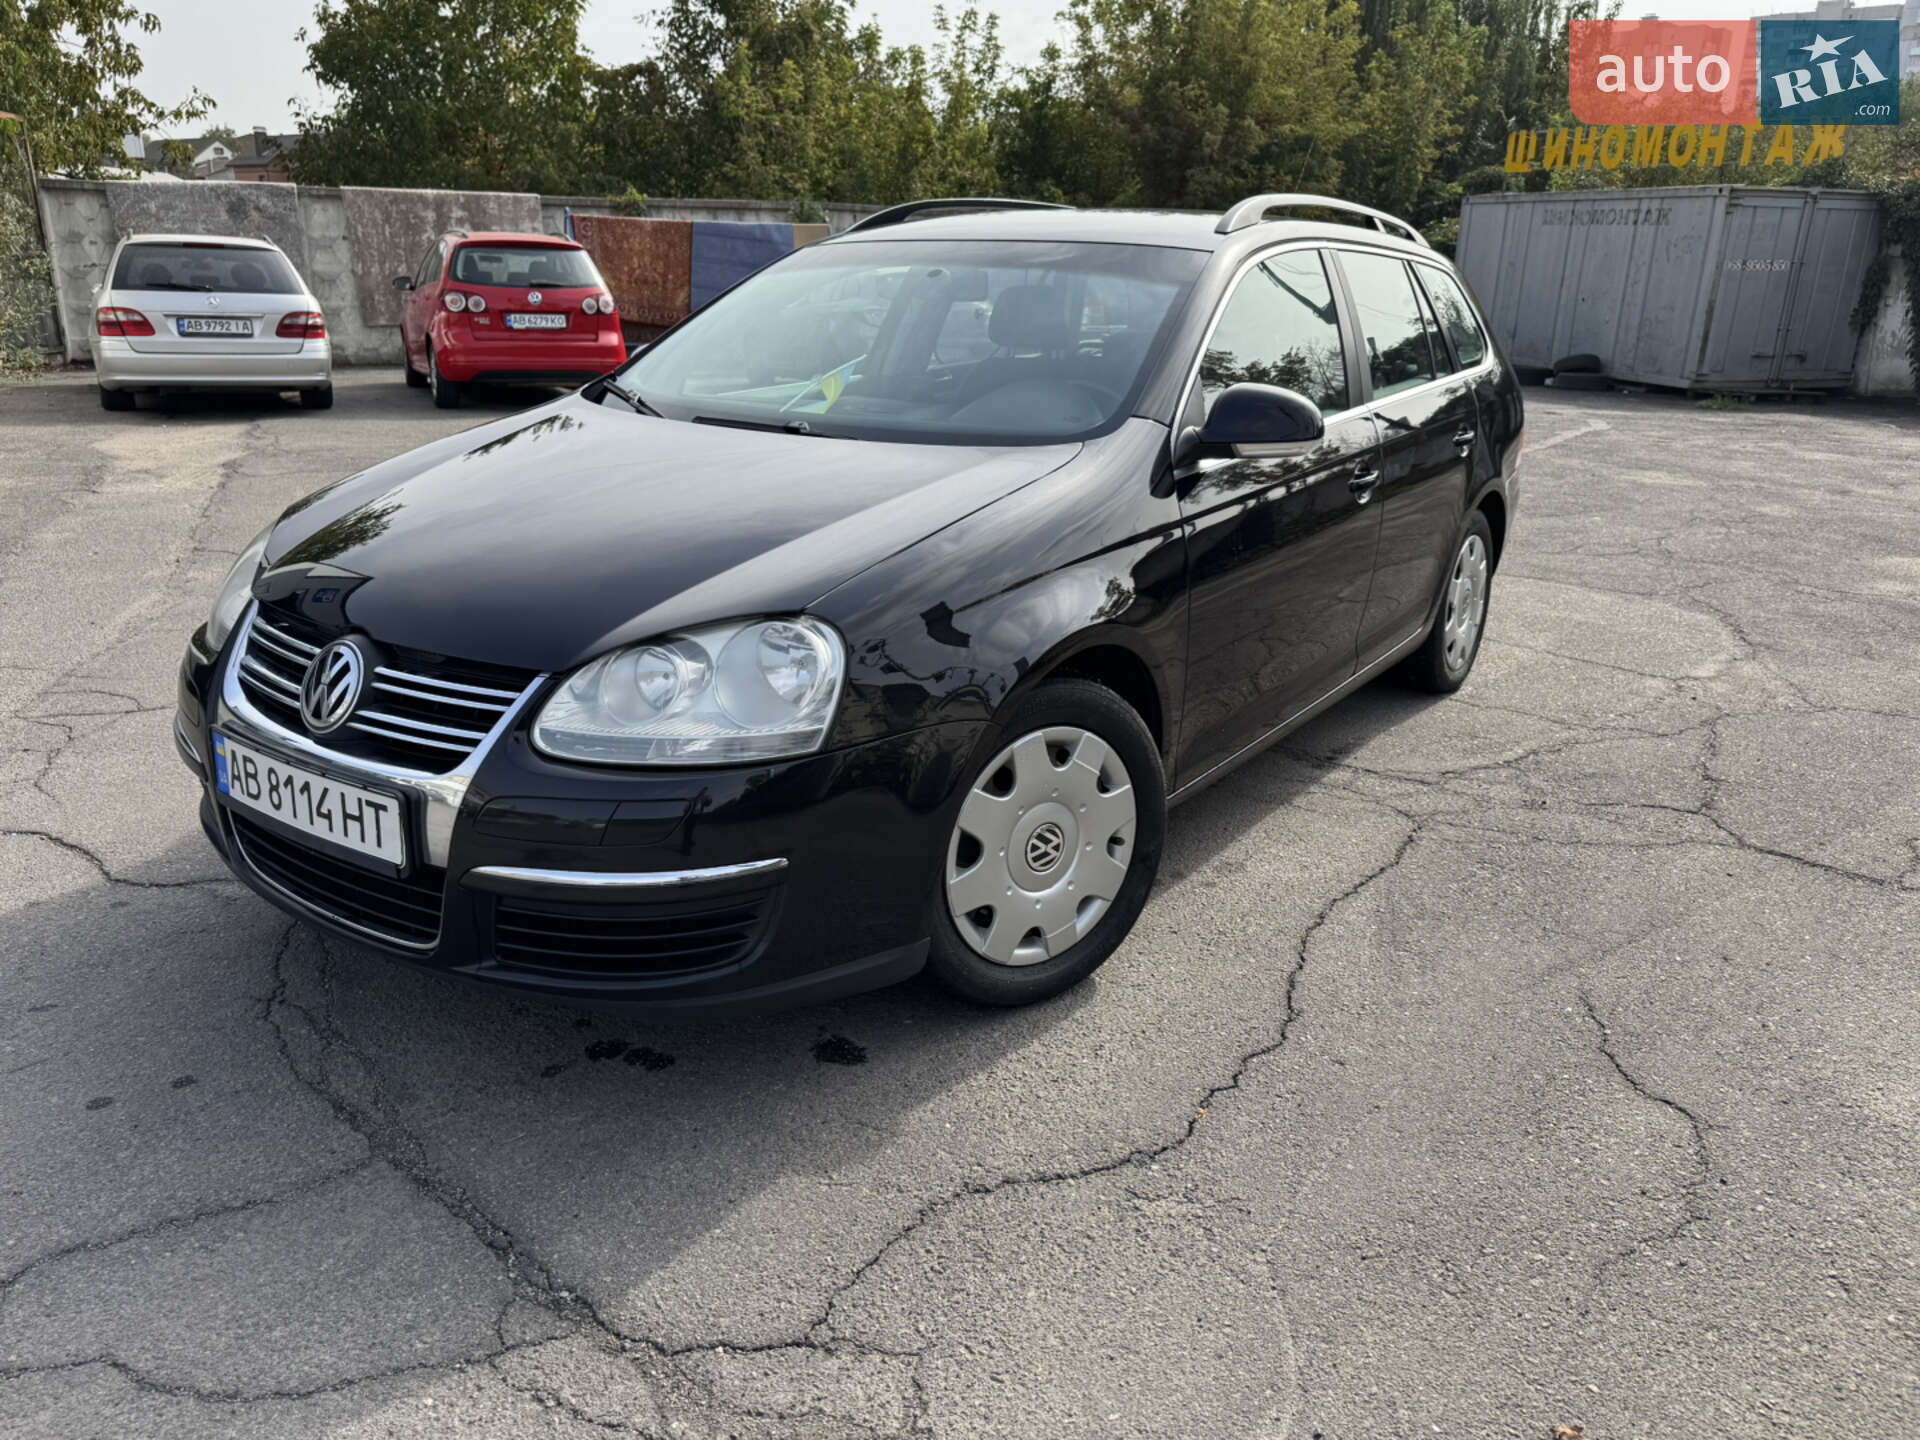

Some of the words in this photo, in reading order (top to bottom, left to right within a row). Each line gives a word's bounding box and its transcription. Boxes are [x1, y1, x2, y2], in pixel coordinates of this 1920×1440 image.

[1504, 117, 1847, 173] ШИНОМОНТАЖ
[204, 321, 232, 331] 9792
[231, 749, 261, 801] AB
[267, 766, 334, 833] 8114
[340, 791, 388, 849] HT
